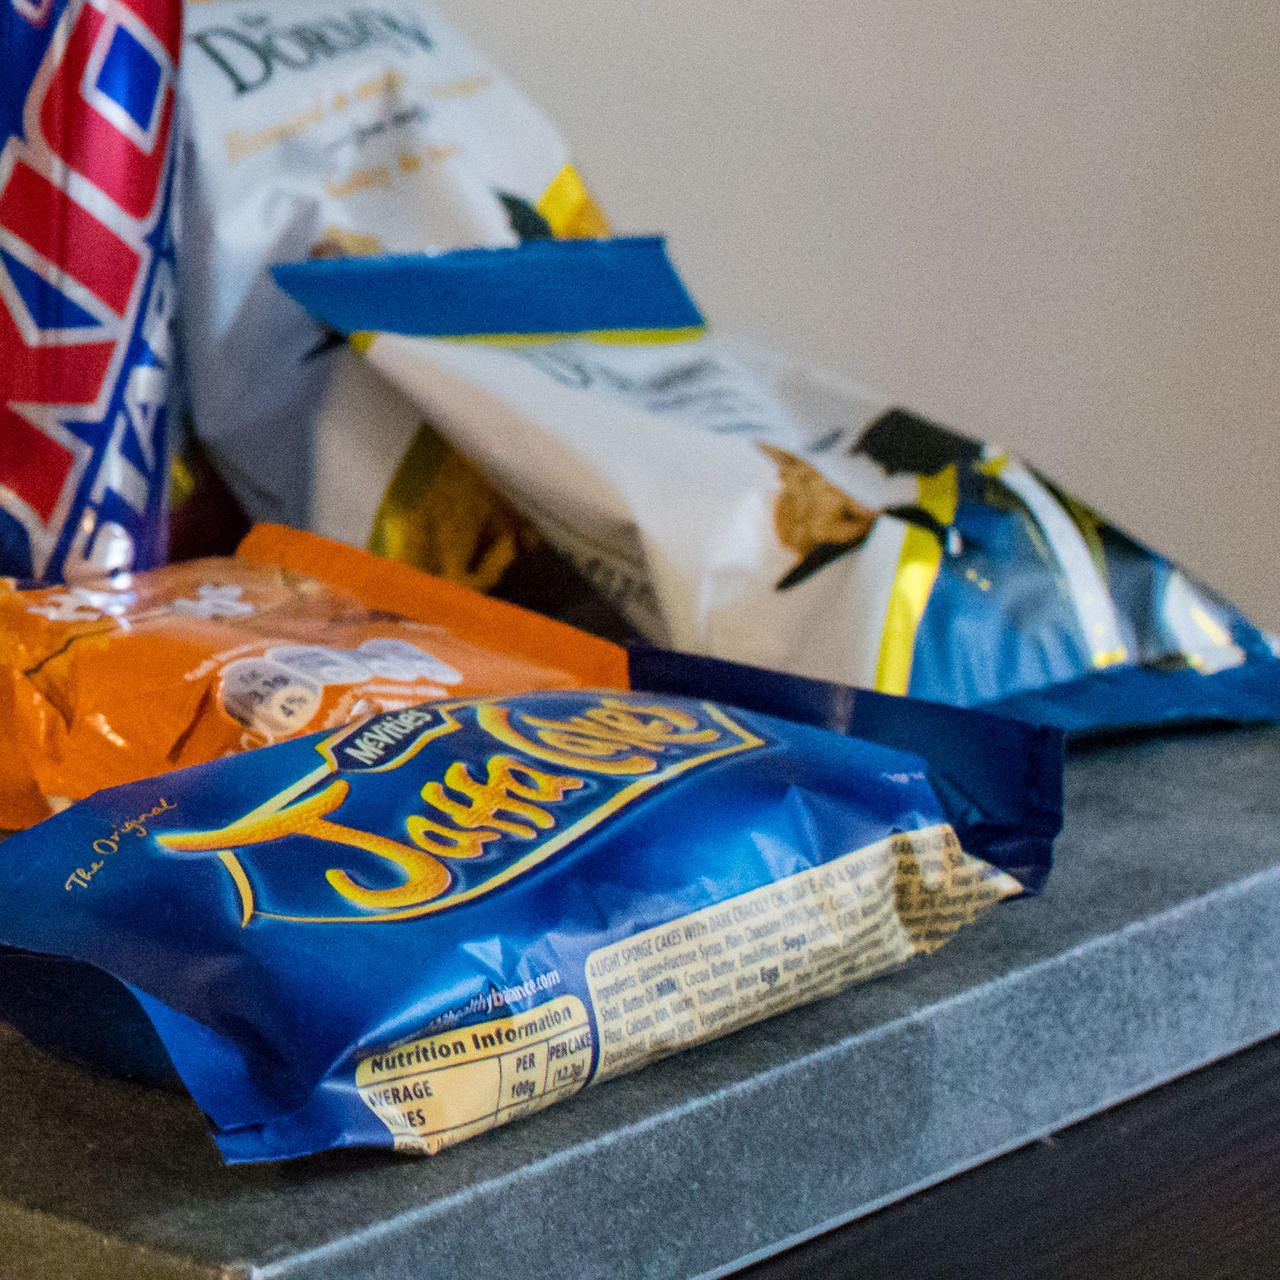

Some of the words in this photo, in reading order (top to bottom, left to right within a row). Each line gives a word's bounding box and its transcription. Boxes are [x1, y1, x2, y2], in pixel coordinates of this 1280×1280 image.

[155, 753, 588, 910] Jaffa
[475, 697, 721, 777] Cakes
[63, 858, 105, 892] The
[91, 796, 178, 856] Original
[370, 1038, 468, 1075] Nutrition
[471, 1004, 574, 1052] Information
[548, 1040, 569, 1062] PER
[515, 1052, 536, 1075] PER
[510, 1079, 536, 1099] 100g
